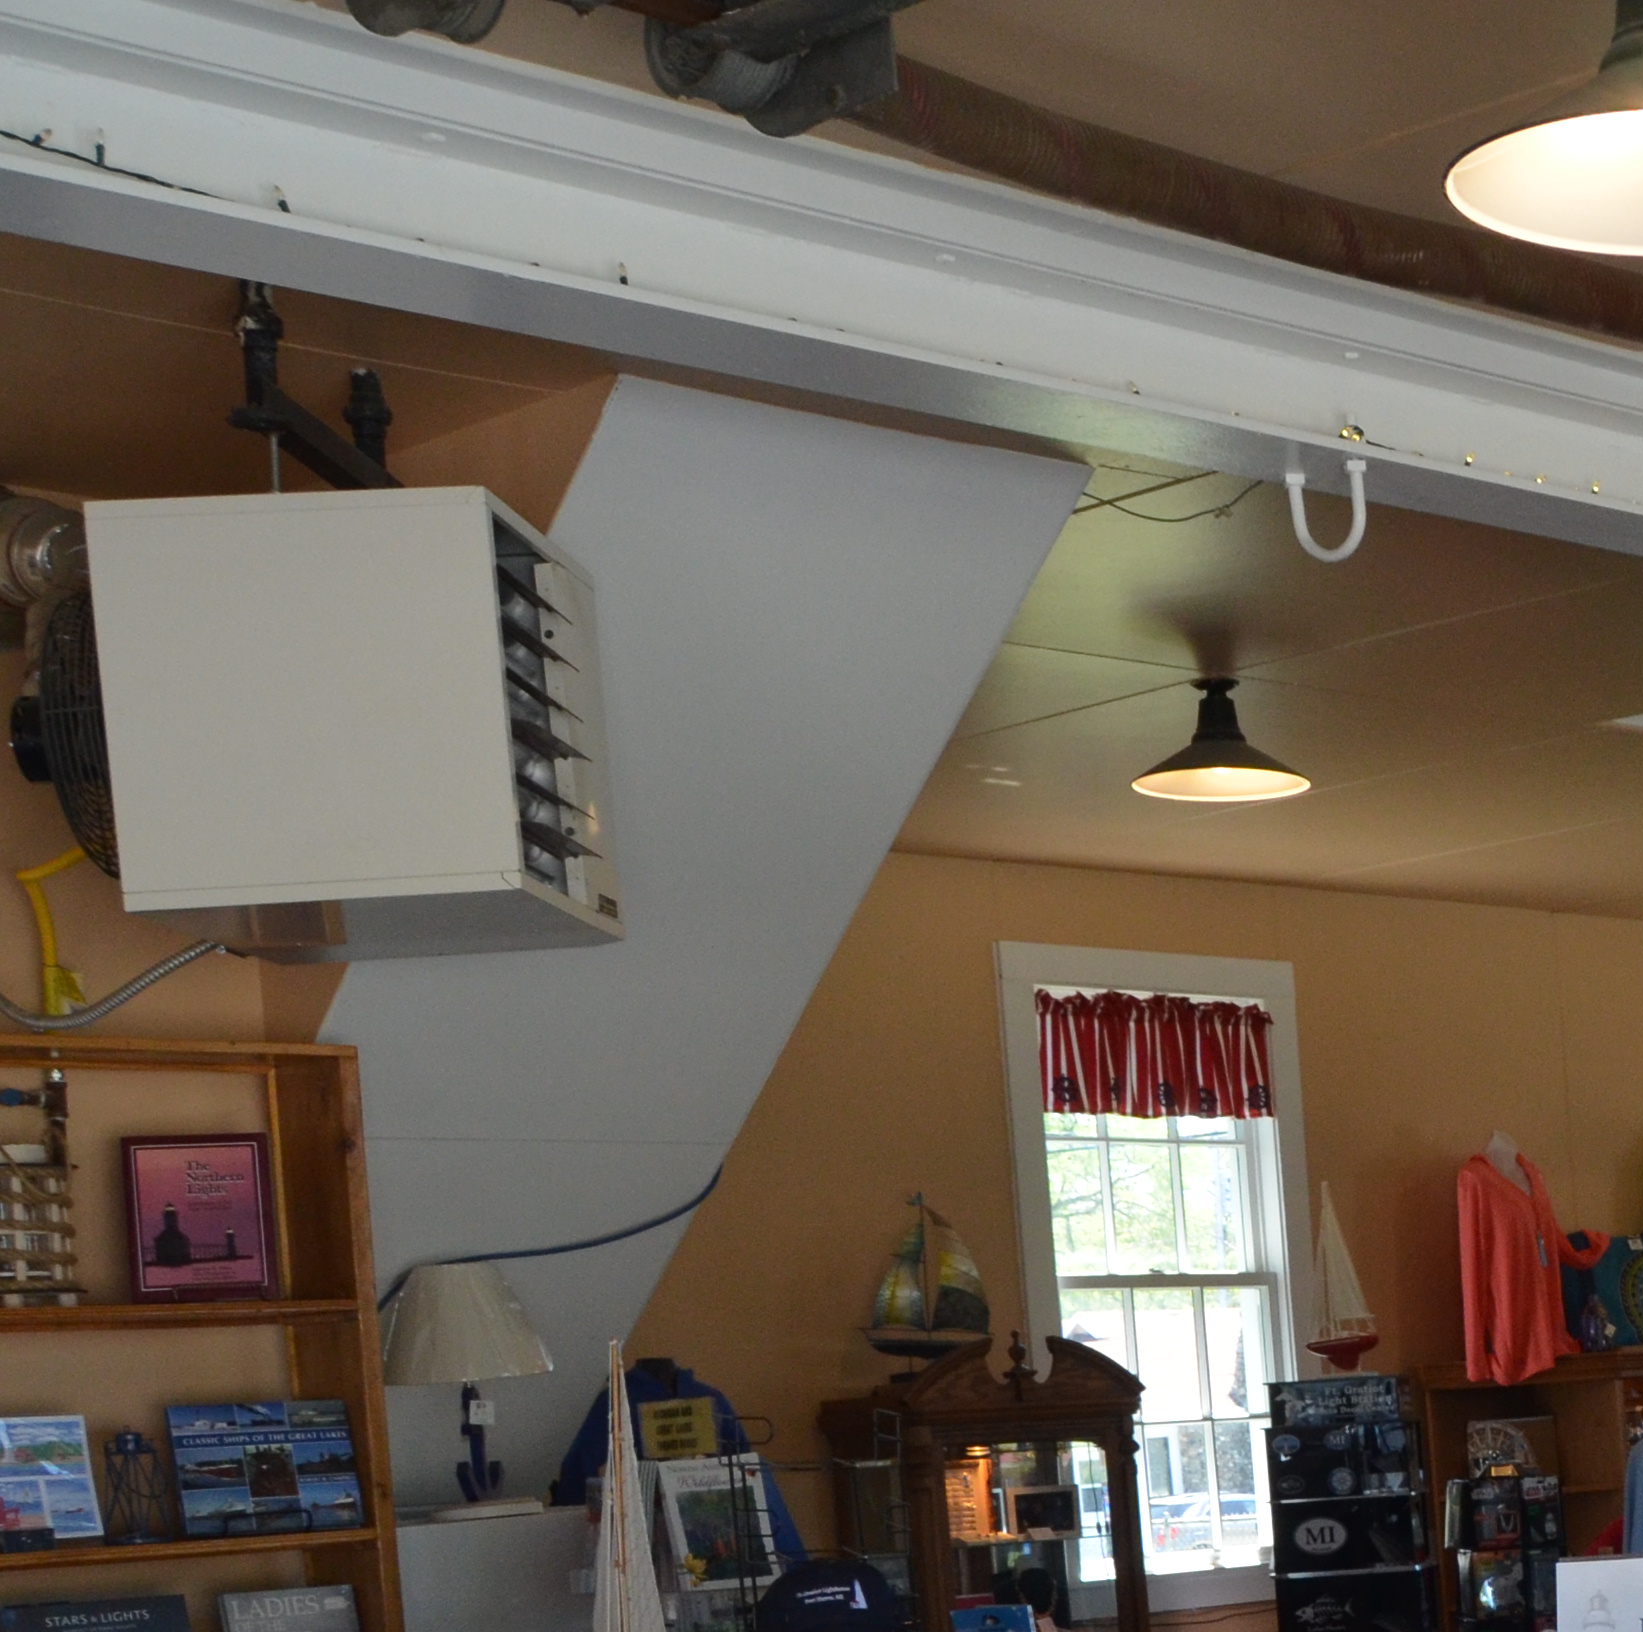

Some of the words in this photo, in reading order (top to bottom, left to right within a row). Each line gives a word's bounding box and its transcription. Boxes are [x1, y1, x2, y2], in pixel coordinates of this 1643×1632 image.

[185, 1161, 210, 1171] The
[185, 1172, 245, 1184] Northern
[185, 1184, 228, 1199] Lights
[183, 1435, 220, 1446] CLASSIC
[223, 1434, 250, 1444] SHIPS
[252, 1433, 264, 1442] OF
[268, 1432, 286, 1442] THE
[288, 1431, 317, 1440] GREAT
[319, 1430, 347, 1439] LAKES
[1305, 1526, 1336, 1545] MI
[231, 1595, 319, 1620] LADIES
[45, 1614, 87, 1627] STARS
[100, 1609, 150, 1623] LIGHTS
[256, 1620, 286, 1632] THE
